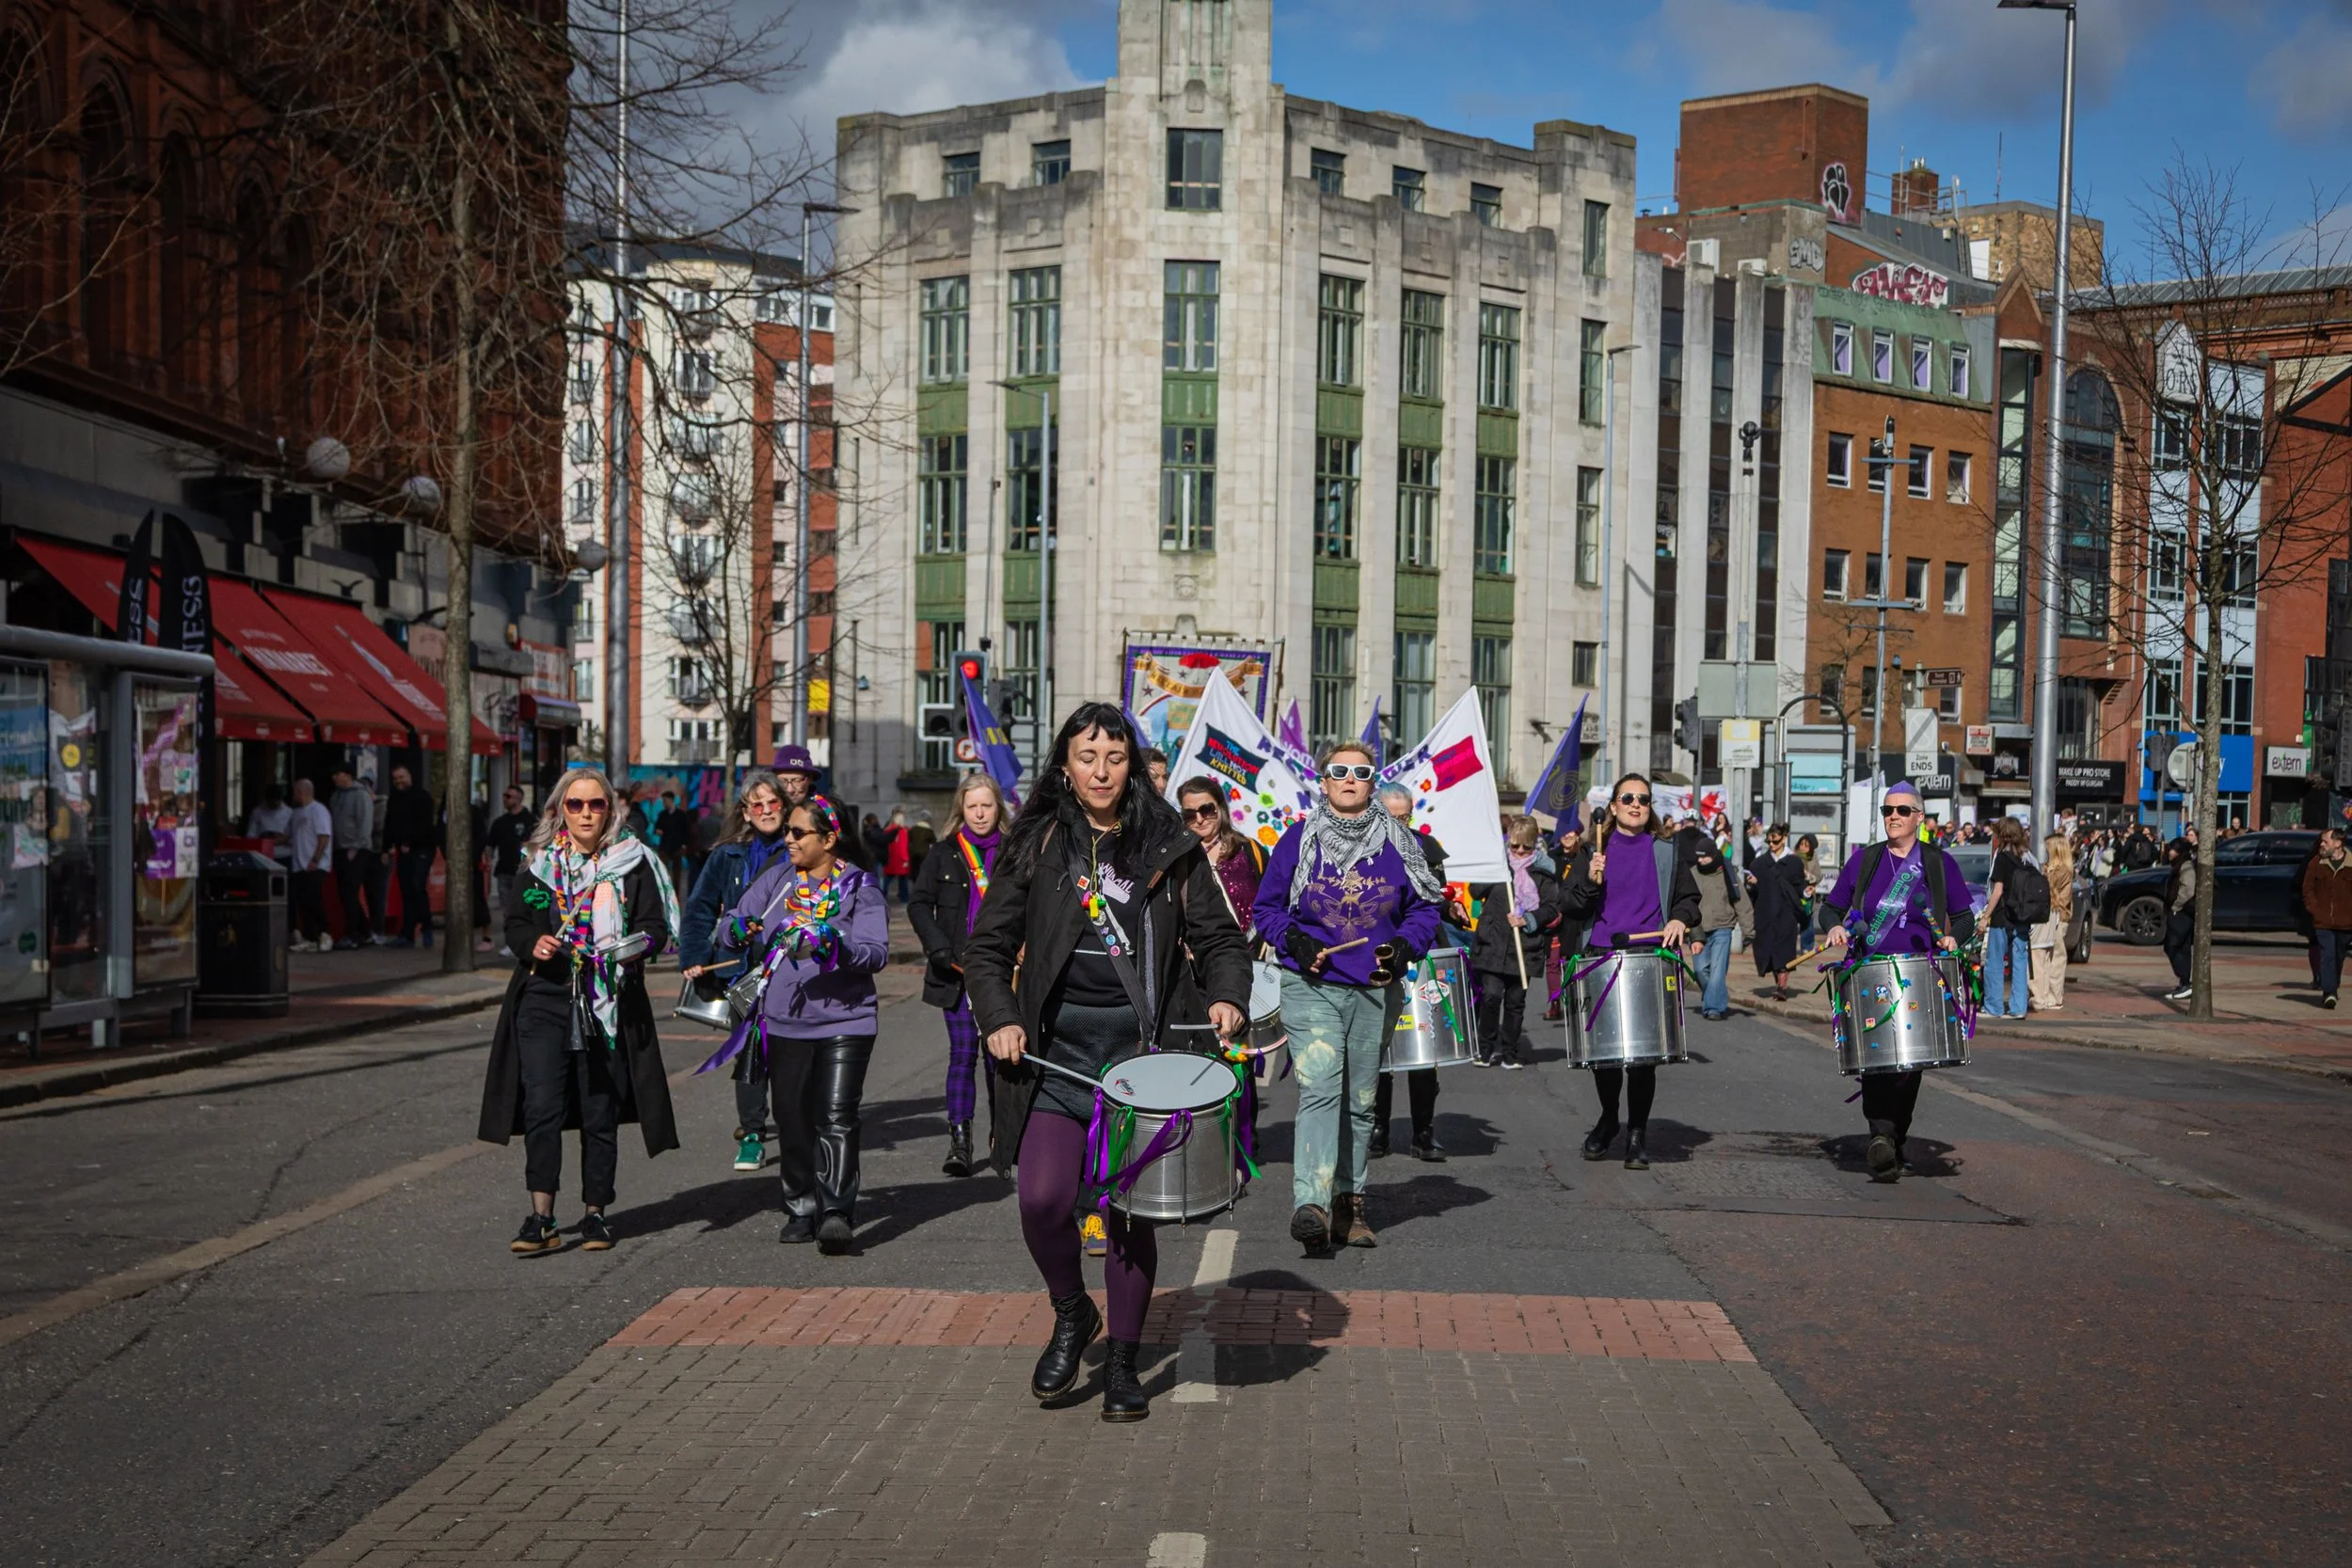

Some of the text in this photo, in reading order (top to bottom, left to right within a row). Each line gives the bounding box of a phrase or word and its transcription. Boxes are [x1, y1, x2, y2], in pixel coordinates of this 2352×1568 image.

[1230, 758, 1247, 776] NOT
[1911, 761, 1932, 771] ENDS
[2271, 752, 2301, 772] extern
[2058, 767, 2111, 778] MAKE UP PRO STORE
